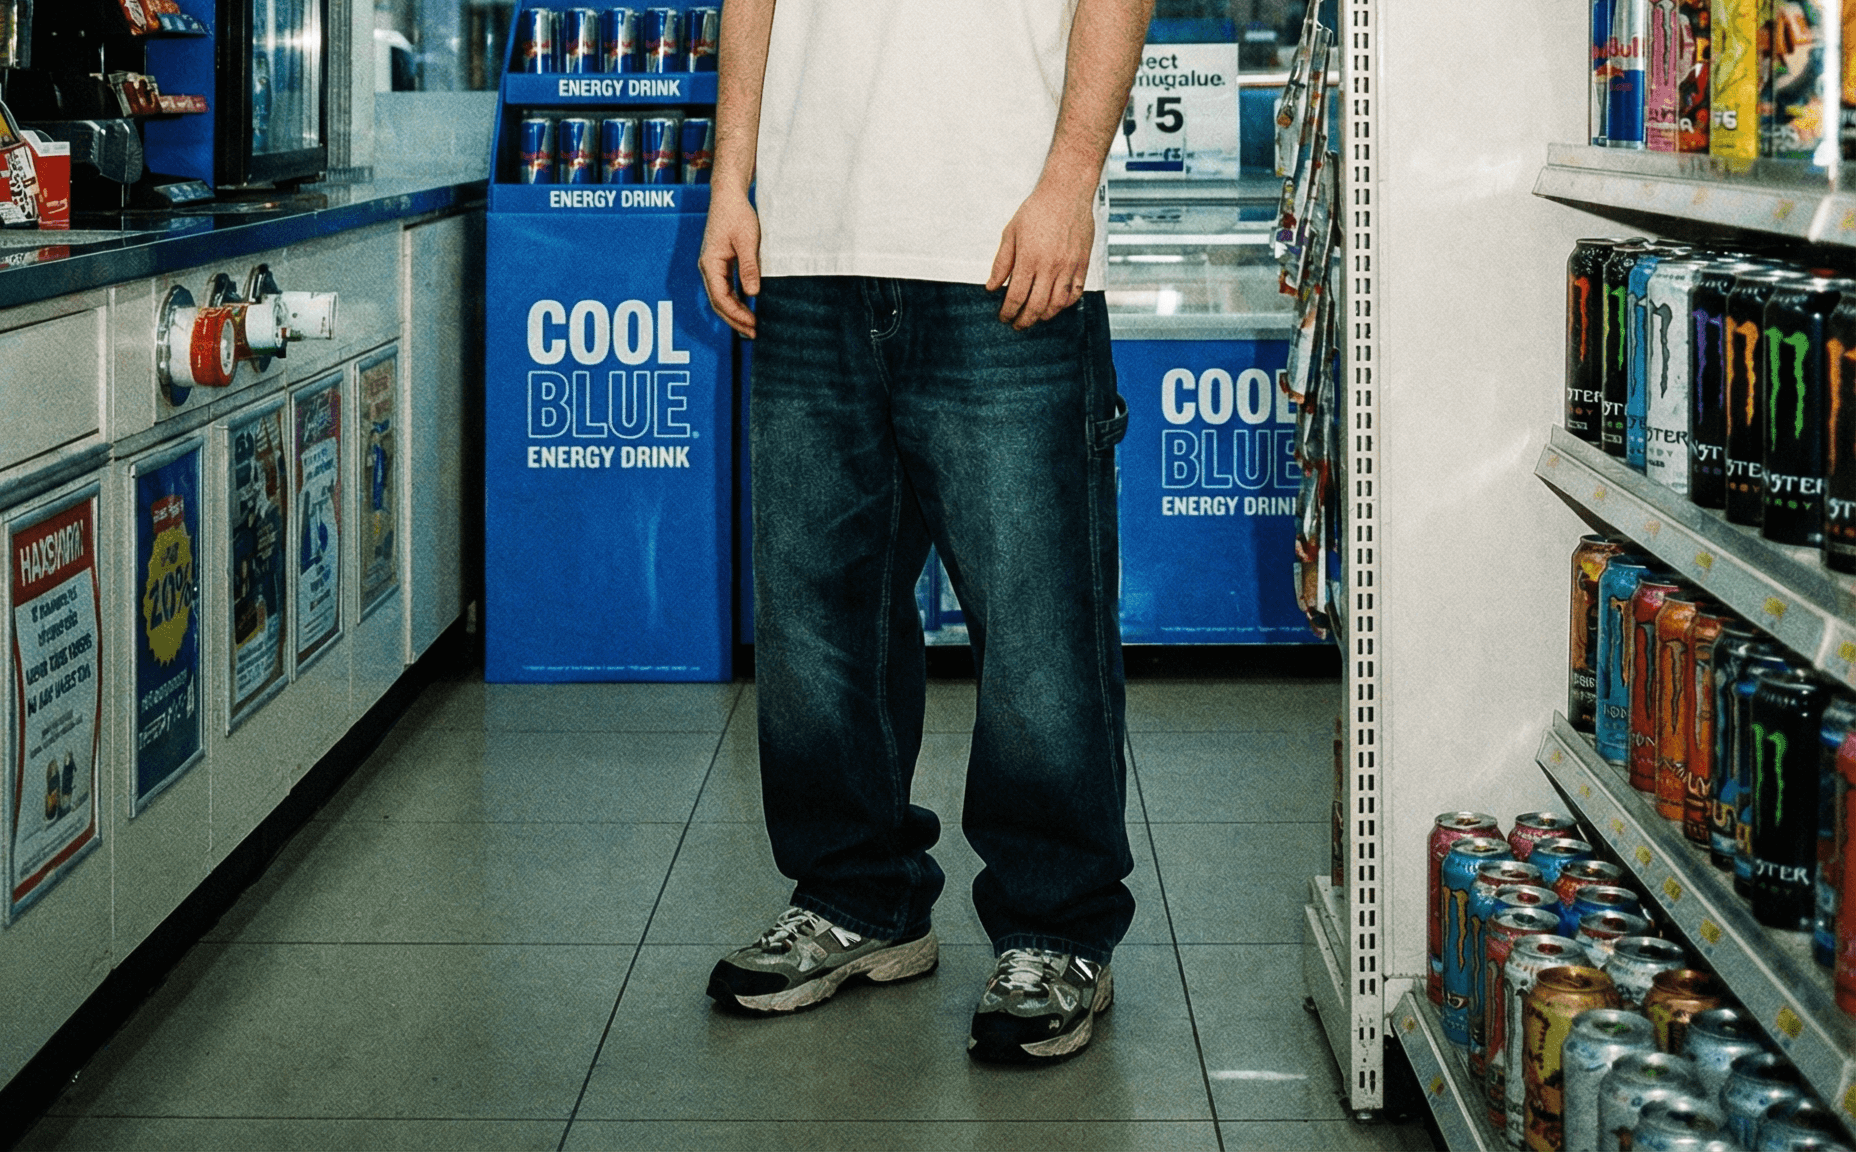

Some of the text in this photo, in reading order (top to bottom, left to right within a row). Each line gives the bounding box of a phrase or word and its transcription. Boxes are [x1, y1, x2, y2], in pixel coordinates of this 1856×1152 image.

[558, 79, 681, 97] ENERGY DRINK
[550, 190, 676, 208] ENERGY DRINK
[526, 300, 690, 365] COOL
[526, 370, 691, 440] BLUE
[1161, 367, 1299, 425] COOL
[527, 446, 691, 469] ENERGY DRINK
[1161, 496, 1239, 516] ENERGY
